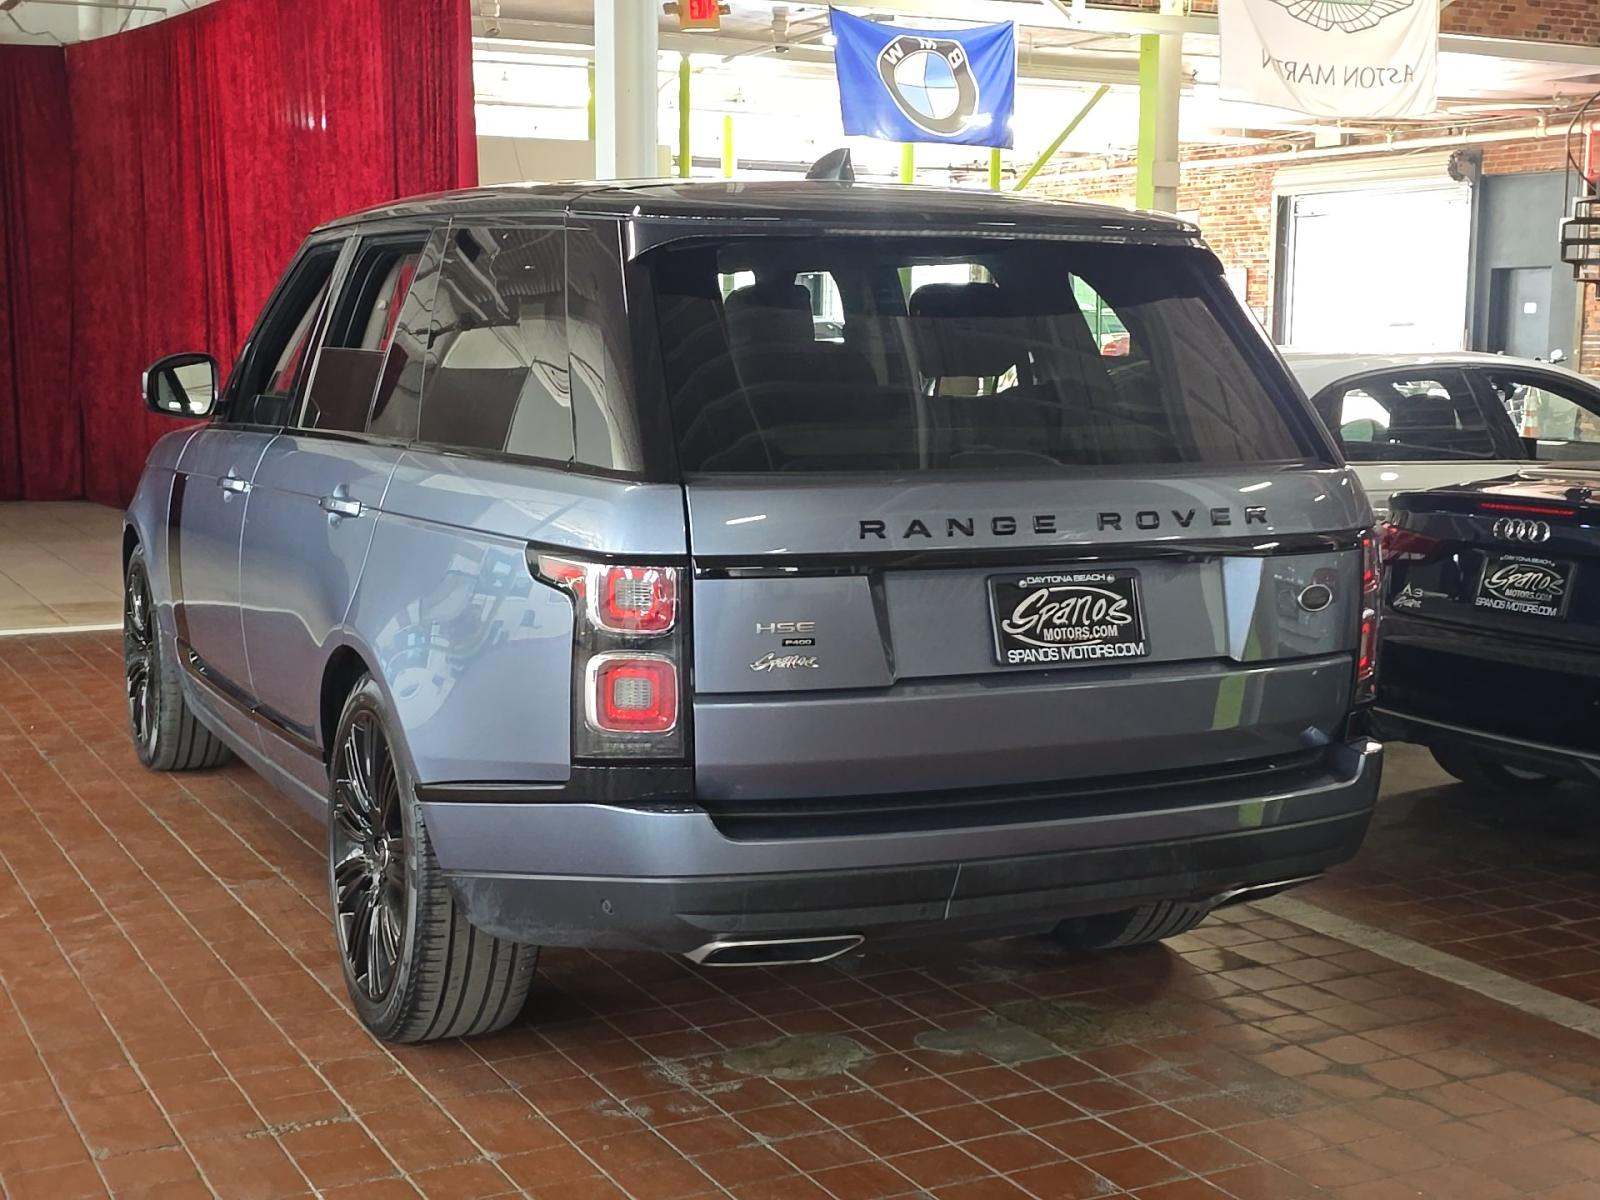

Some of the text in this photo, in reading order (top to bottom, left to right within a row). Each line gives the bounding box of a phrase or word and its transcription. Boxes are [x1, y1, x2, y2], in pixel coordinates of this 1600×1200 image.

[859, 506, 1268, 540] RANGE ROVER
[1026, 573, 1106, 585] DAYTONA BEACH
[1484, 564, 1564, 595] Spanos
[1400, 583, 1424, 598] A3
[1002, 588, 1132, 634] Spanos
[1475, 597, 1506, 609] SPANOS
[756, 622, 816, 634] HSE
[1043, 624, 1118, 641] MOTORS.COM
[1007, 642, 1145, 663] SPANOS MOTORS.COM
